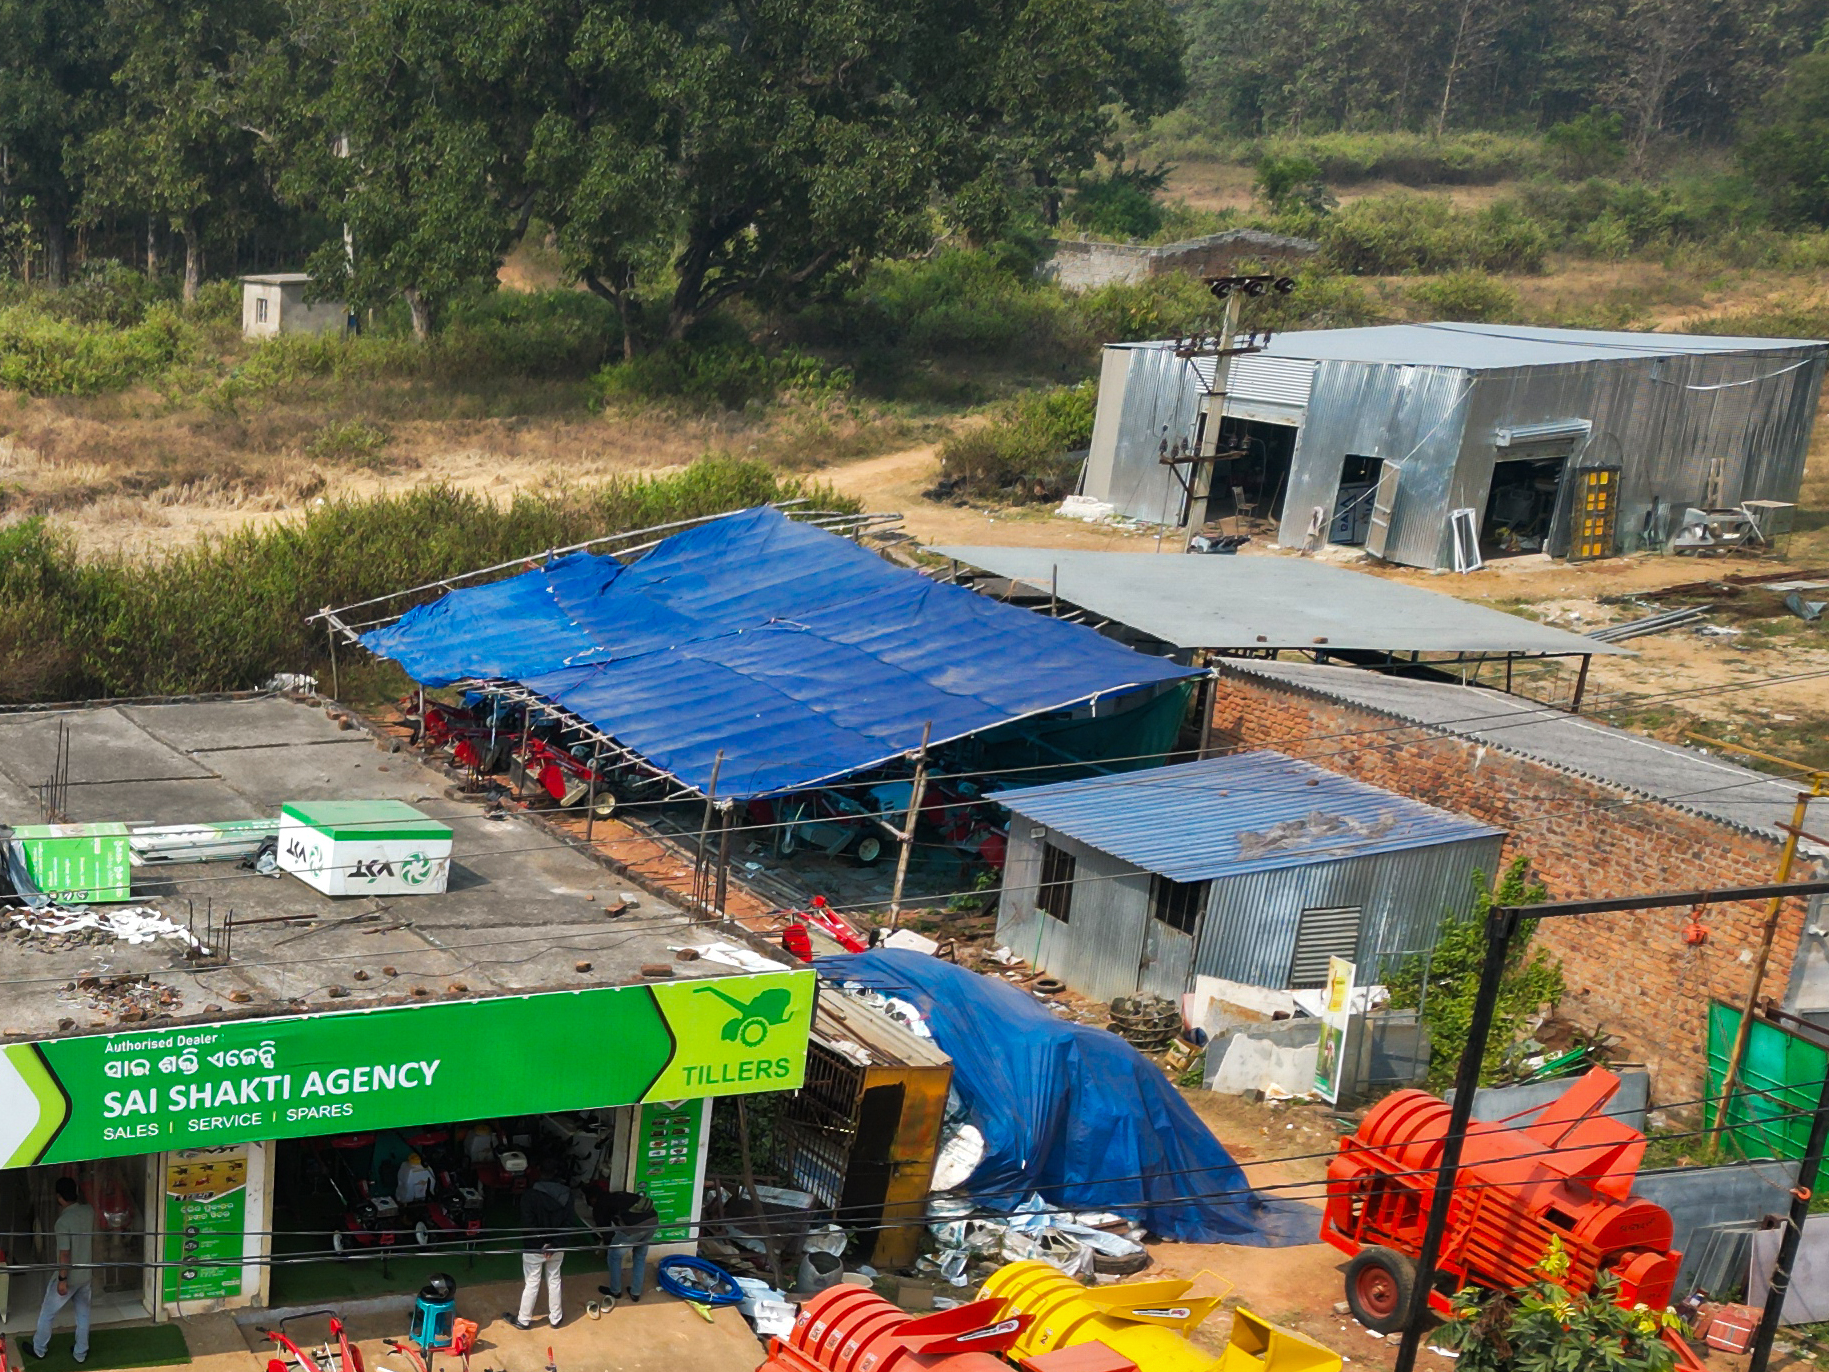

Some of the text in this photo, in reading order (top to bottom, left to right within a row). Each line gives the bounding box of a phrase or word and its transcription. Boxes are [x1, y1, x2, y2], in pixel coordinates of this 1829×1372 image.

[347, 859, 396, 884] VST
[105, 1032, 219, 1053] Authorised Dealer
[105, 1058, 150, 1079] ସାଇ
[682, 1057, 791, 1087] TILLERS
[103, 1059, 441, 1119] SAI SHAKTI AGENCY
[103, 1103, 354, 1141] SALES SERVICE SPARES
